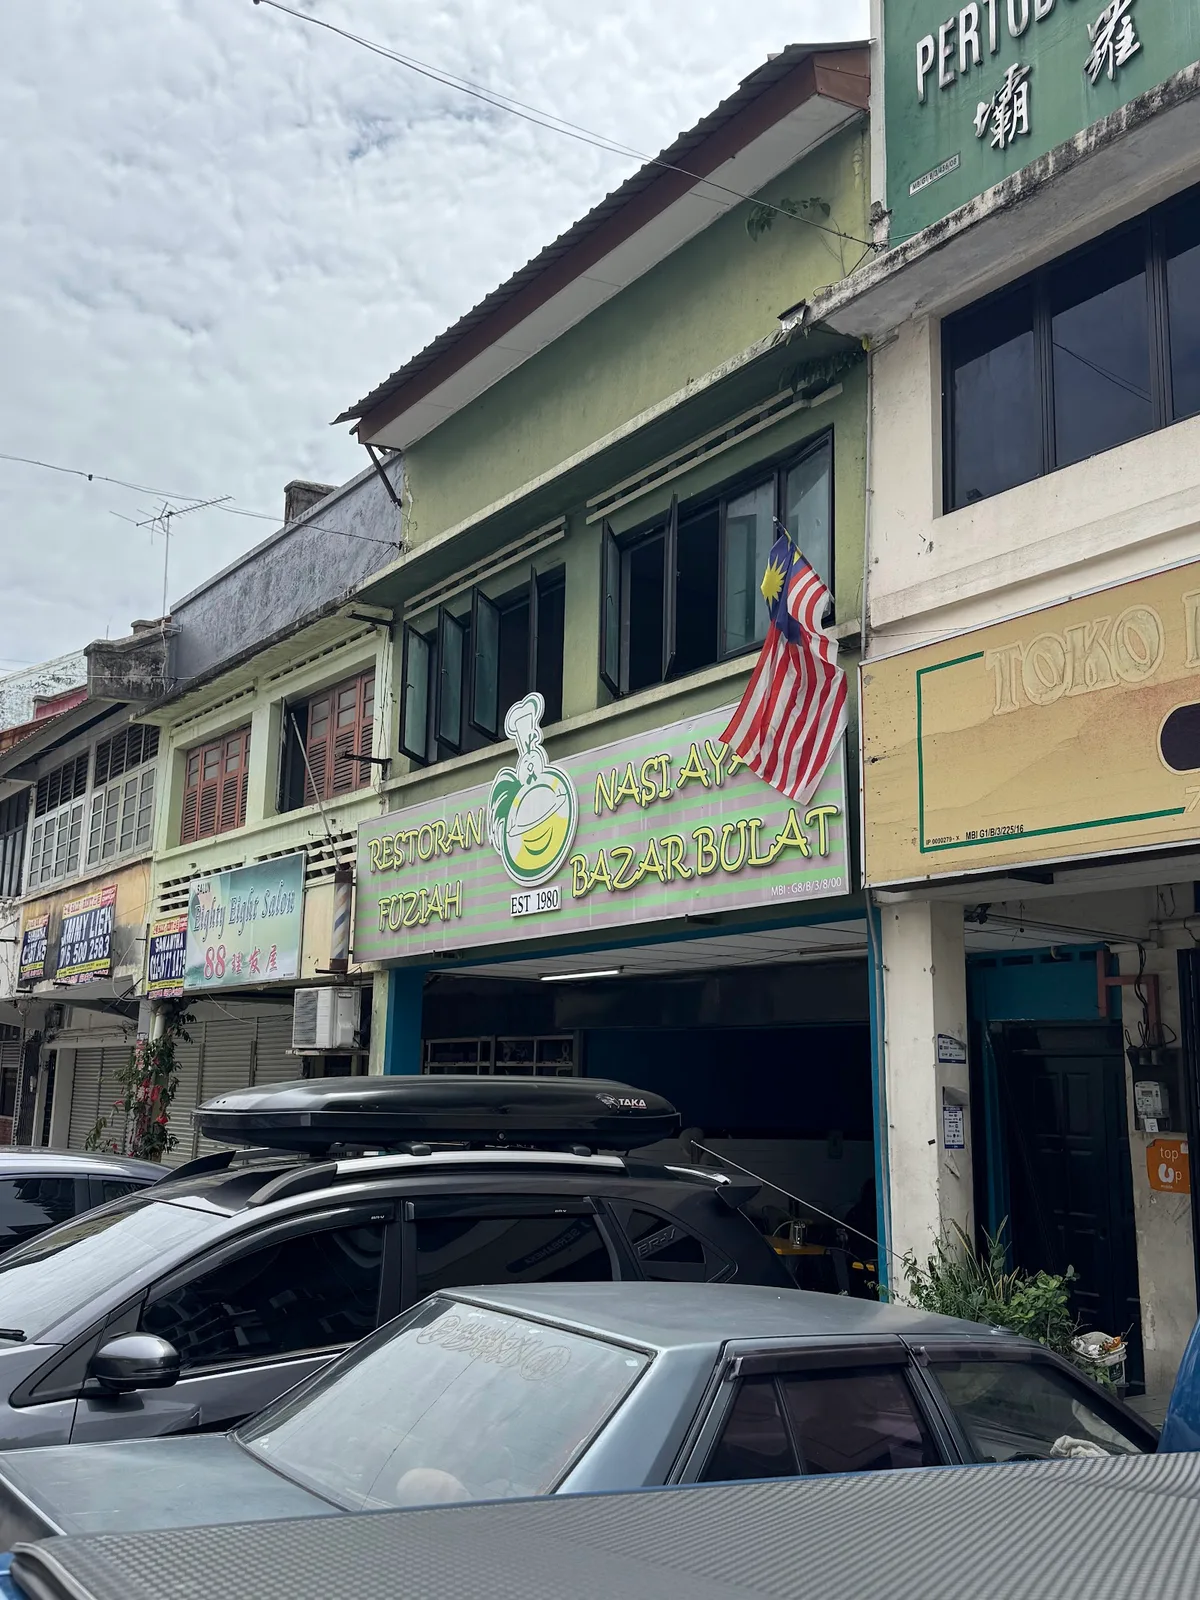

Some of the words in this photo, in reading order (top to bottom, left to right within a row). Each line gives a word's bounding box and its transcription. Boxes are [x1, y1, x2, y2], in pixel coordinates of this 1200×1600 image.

[985, 604, 1165, 715] TOKO
[594, 752, 673, 816] NASI
[367, 807, 485, 874] RESTORAN
[965, 830, 978, 840] MBI
[980, 824, 1024, 838] G1/B/3/225/16
[569, 838, 692, 899] BAZAR
[692, 805, 840, 877] BULAT
[511, 895, 531, 914] EST
[536, 889, 559, 910] 1980
[771, 885, 786, 896] MBI
[791, 876, 842, 893] G8/B/3/8/00
[193, 896, 226, 942] Eighty
[229, 887, 259, 936] Eight
[262, 880, 295, 918] Salon
[378, 880, 463, 933] FUZIAH
[72, 941, 88, 964] 500
[89, 935, 110, 960] 2583
[204, 944, 226, 980] 88
[618, 1098, 646, 1107] TAKA
[1160, 1146, 1179, 1162] top
[637, 1228, 676, 1256] BR-V
